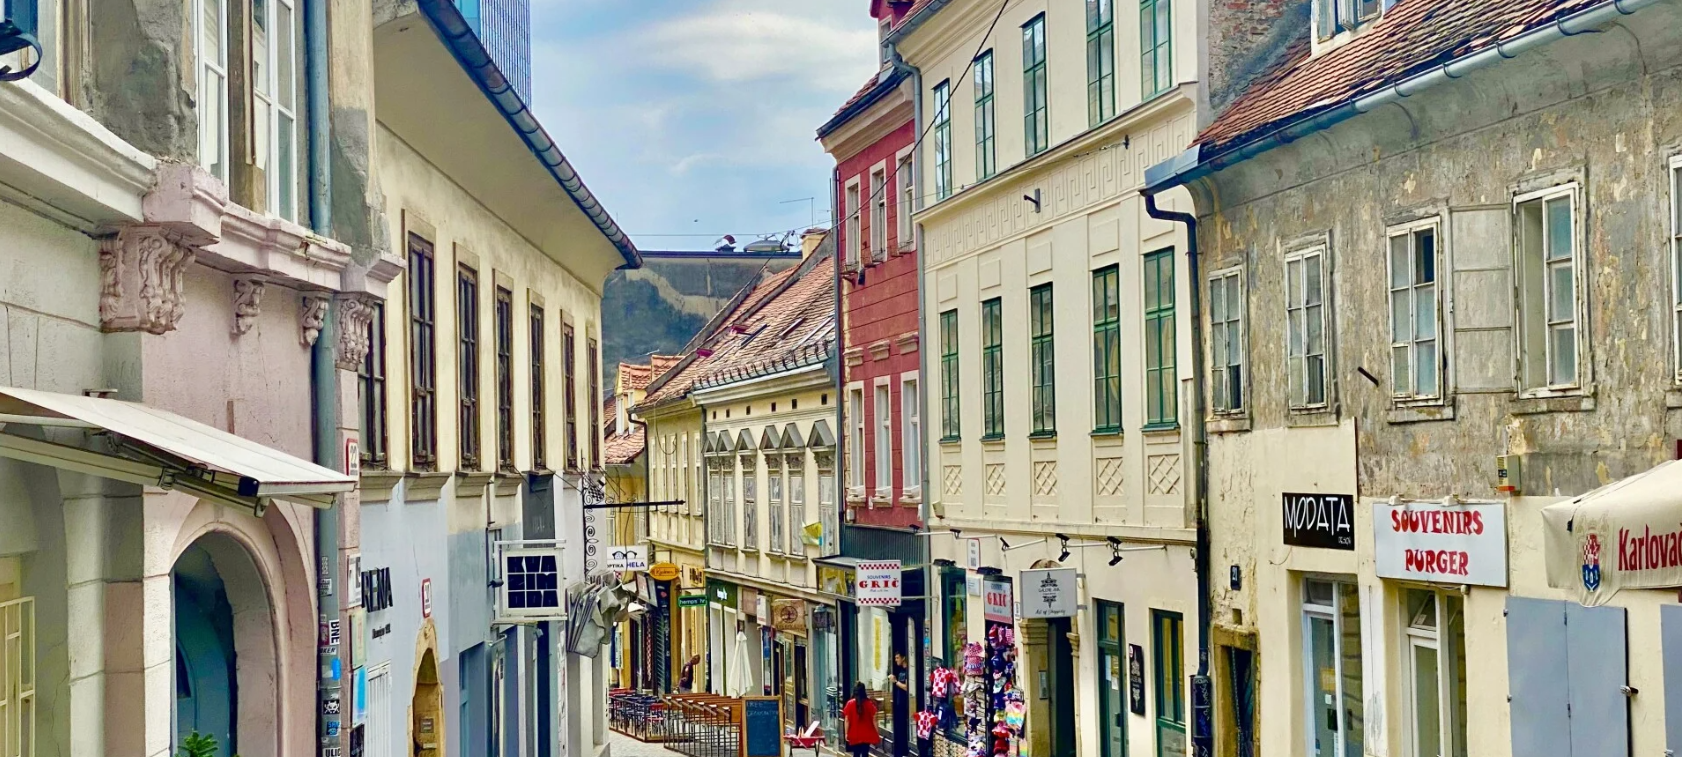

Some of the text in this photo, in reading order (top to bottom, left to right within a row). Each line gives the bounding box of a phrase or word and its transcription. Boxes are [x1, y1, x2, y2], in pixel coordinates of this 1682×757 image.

[1284, 496, 1350, 538] MODATA
[1391, 509, 1484, 535] SOUVENIRS
[1405, 549, 1469, 576] PURGER
[858, 578, 900, 589] GRIČ
